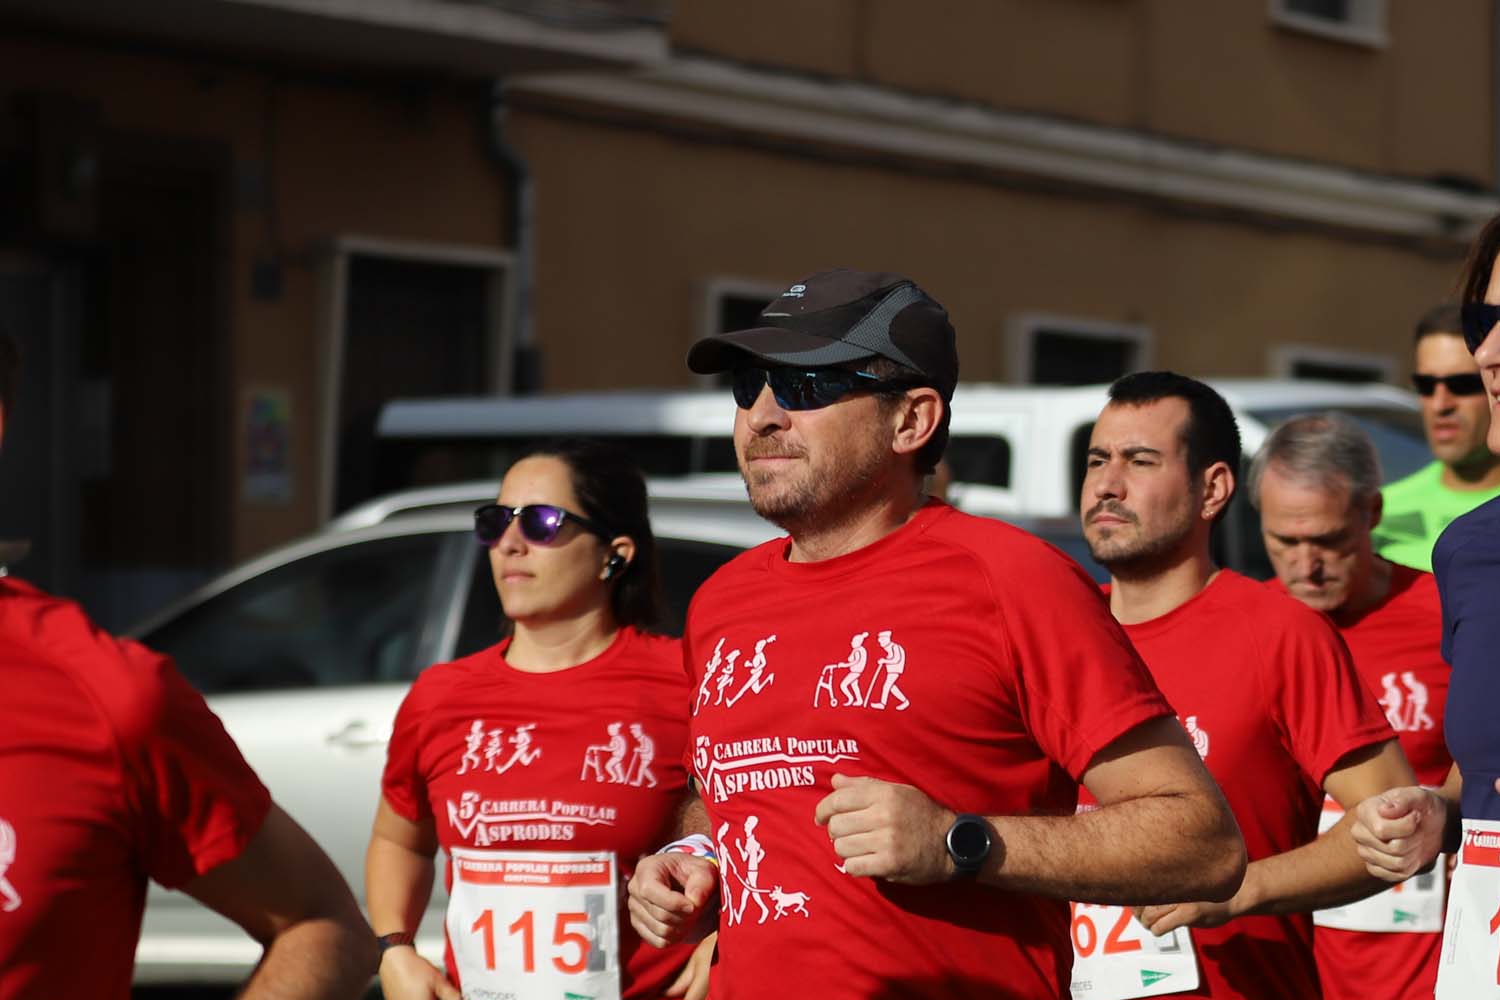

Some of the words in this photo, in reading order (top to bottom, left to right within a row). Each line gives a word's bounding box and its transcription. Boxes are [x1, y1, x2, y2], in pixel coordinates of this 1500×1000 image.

[714, 737, 781, 761] CARRERA
[786, 736, 858, 756] POPULAR
[713, 765, 816, 804] ASPRODES
[480, 800, 546, 816] CARRERA
[551, 801, 616, 821] POPULAR
[474, 823, 574, 847] ASPRODES
[471, 909, 593, 975] 115
